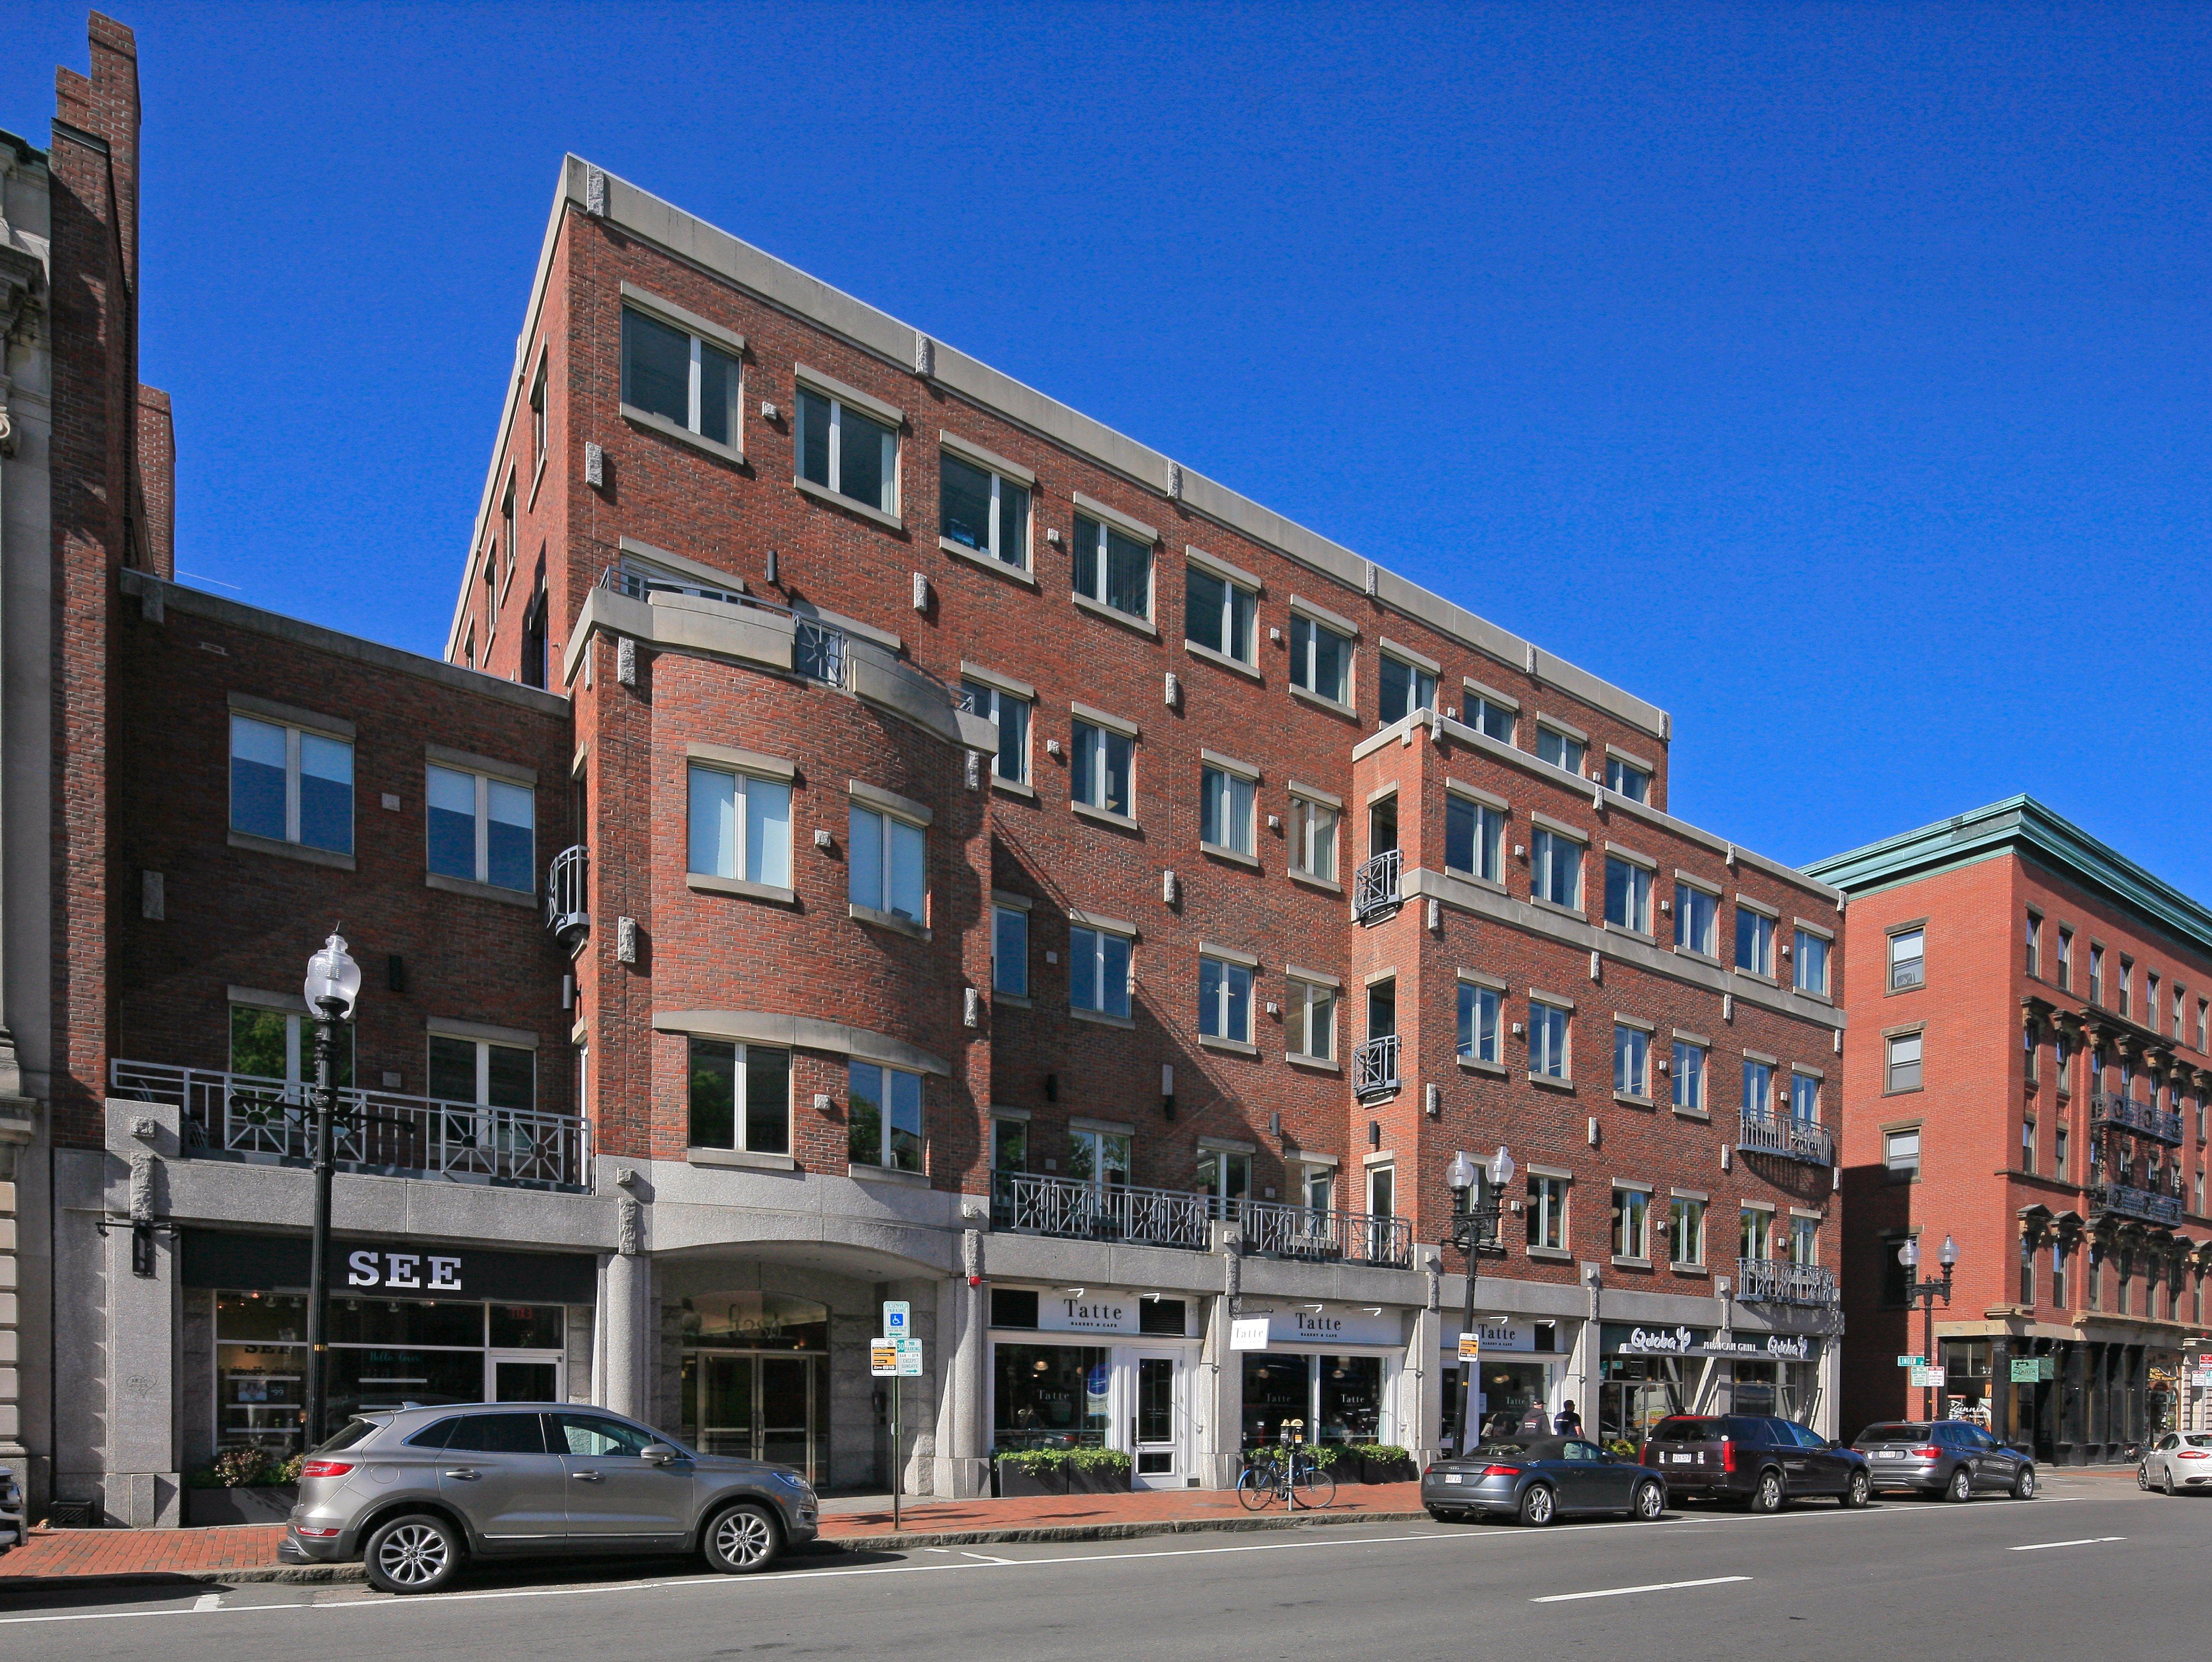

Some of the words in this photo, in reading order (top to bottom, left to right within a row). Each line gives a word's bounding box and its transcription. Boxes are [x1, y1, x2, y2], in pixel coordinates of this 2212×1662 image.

[348, 1251, 461, 1290] SEE
[1064, 1299, 1122, 1319] Tatte
[1296, 1313, 1342, 1331] Tatte
[1234, 1327, 1264, 1338] Tatte
[1478, 1324, 1515, 1340] Tatte
[1631, 1327, 1676, 1352] Qdoba
[897, 1342, 904, 1351] 30
[1703, 1340, 1736, 1351] MEXICAN
[1738, 1342, 1758, 1352] GRILL
[1899, 1357, 1917, 1365] LINDEN
[1037, 1389, 1070, 1400] Tatte
[1266, 1393, 1291, 1402] Tatte
[1341, 1394, 1365, 1403] Tatte
[1506, 1396, 1525, 1405] Tatte
